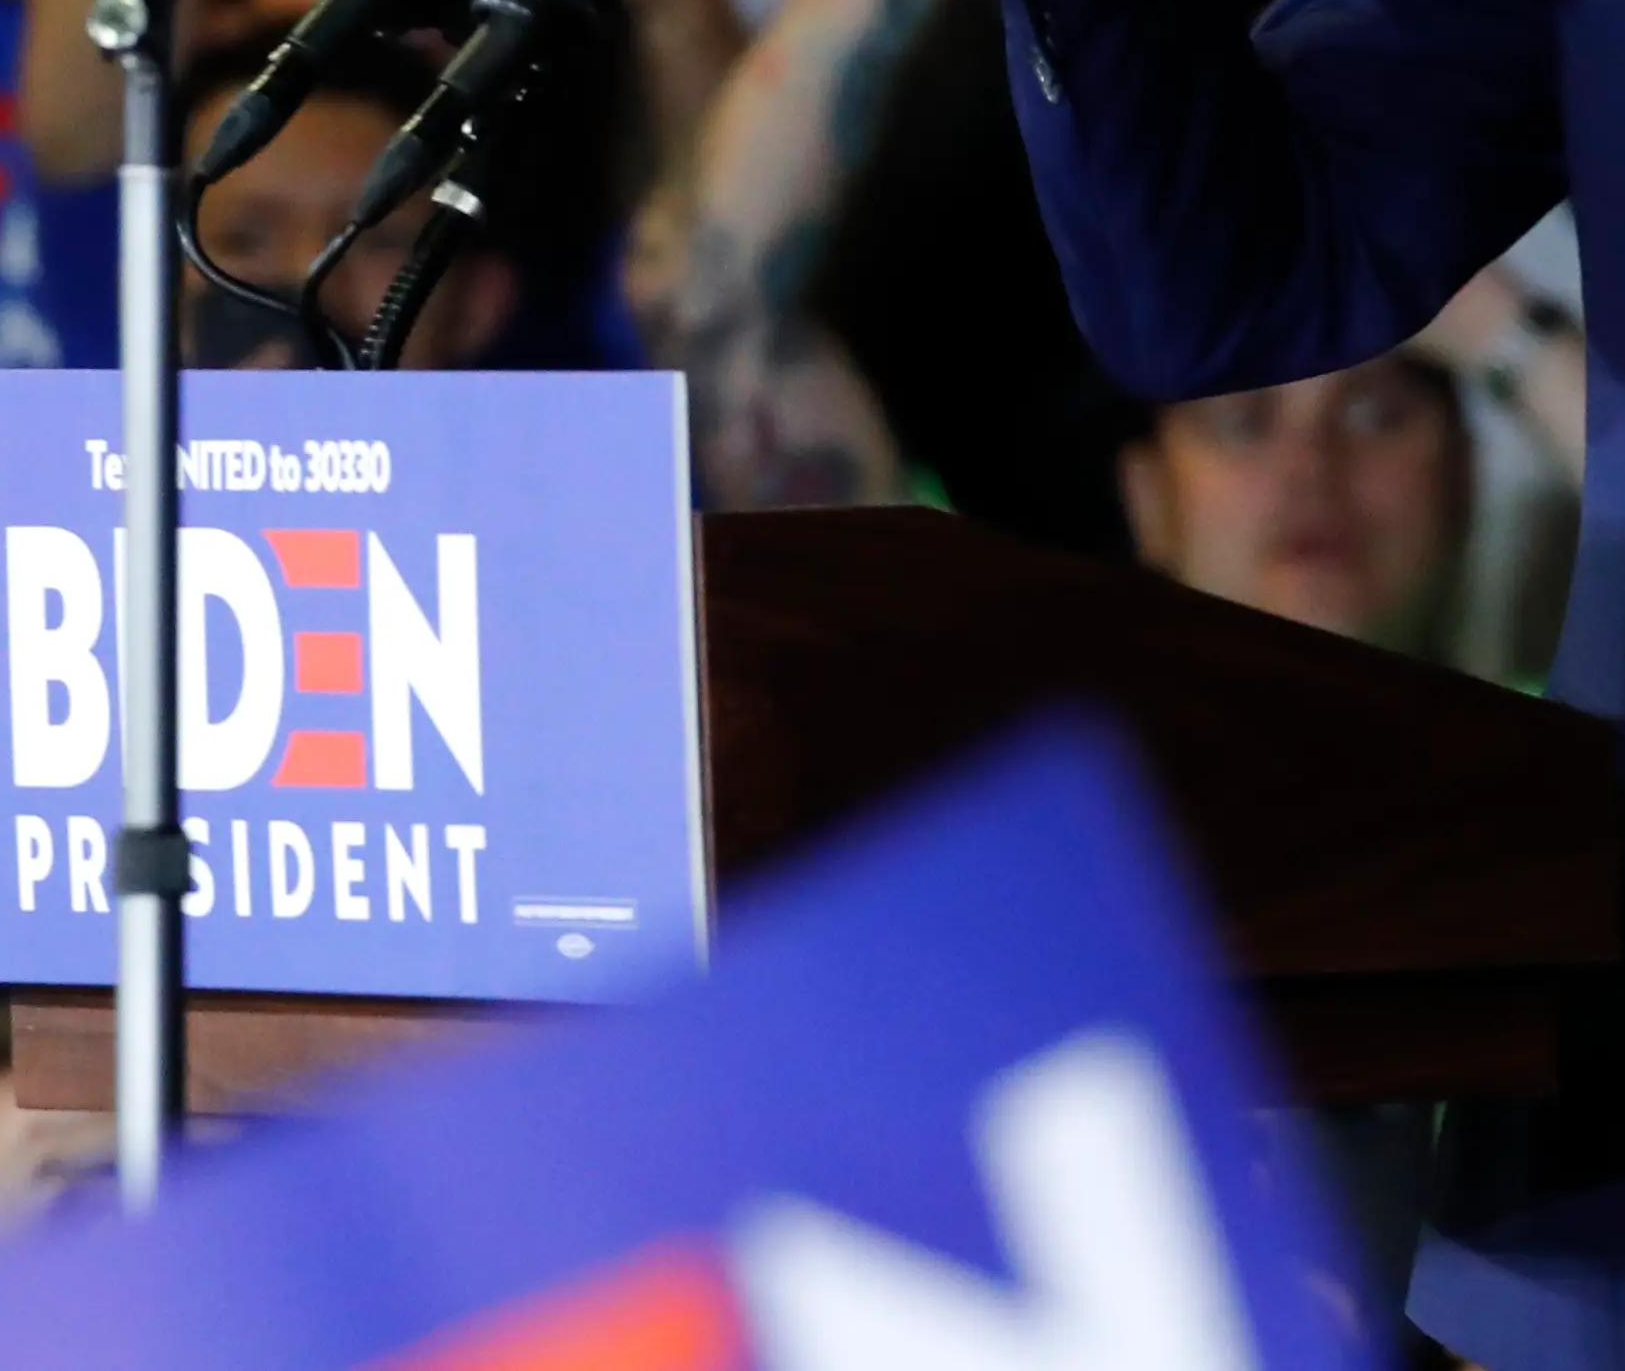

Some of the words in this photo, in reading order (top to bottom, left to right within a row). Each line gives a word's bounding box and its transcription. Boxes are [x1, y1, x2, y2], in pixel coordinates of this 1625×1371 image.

[176, 438, 267, 492] NITED
[270, 444, 302, 493] to
[303, 438, 392, 494] 30330
[5, 525, 485, 796] BDEN
[14, 814, 487, 924] PRSIDENT
